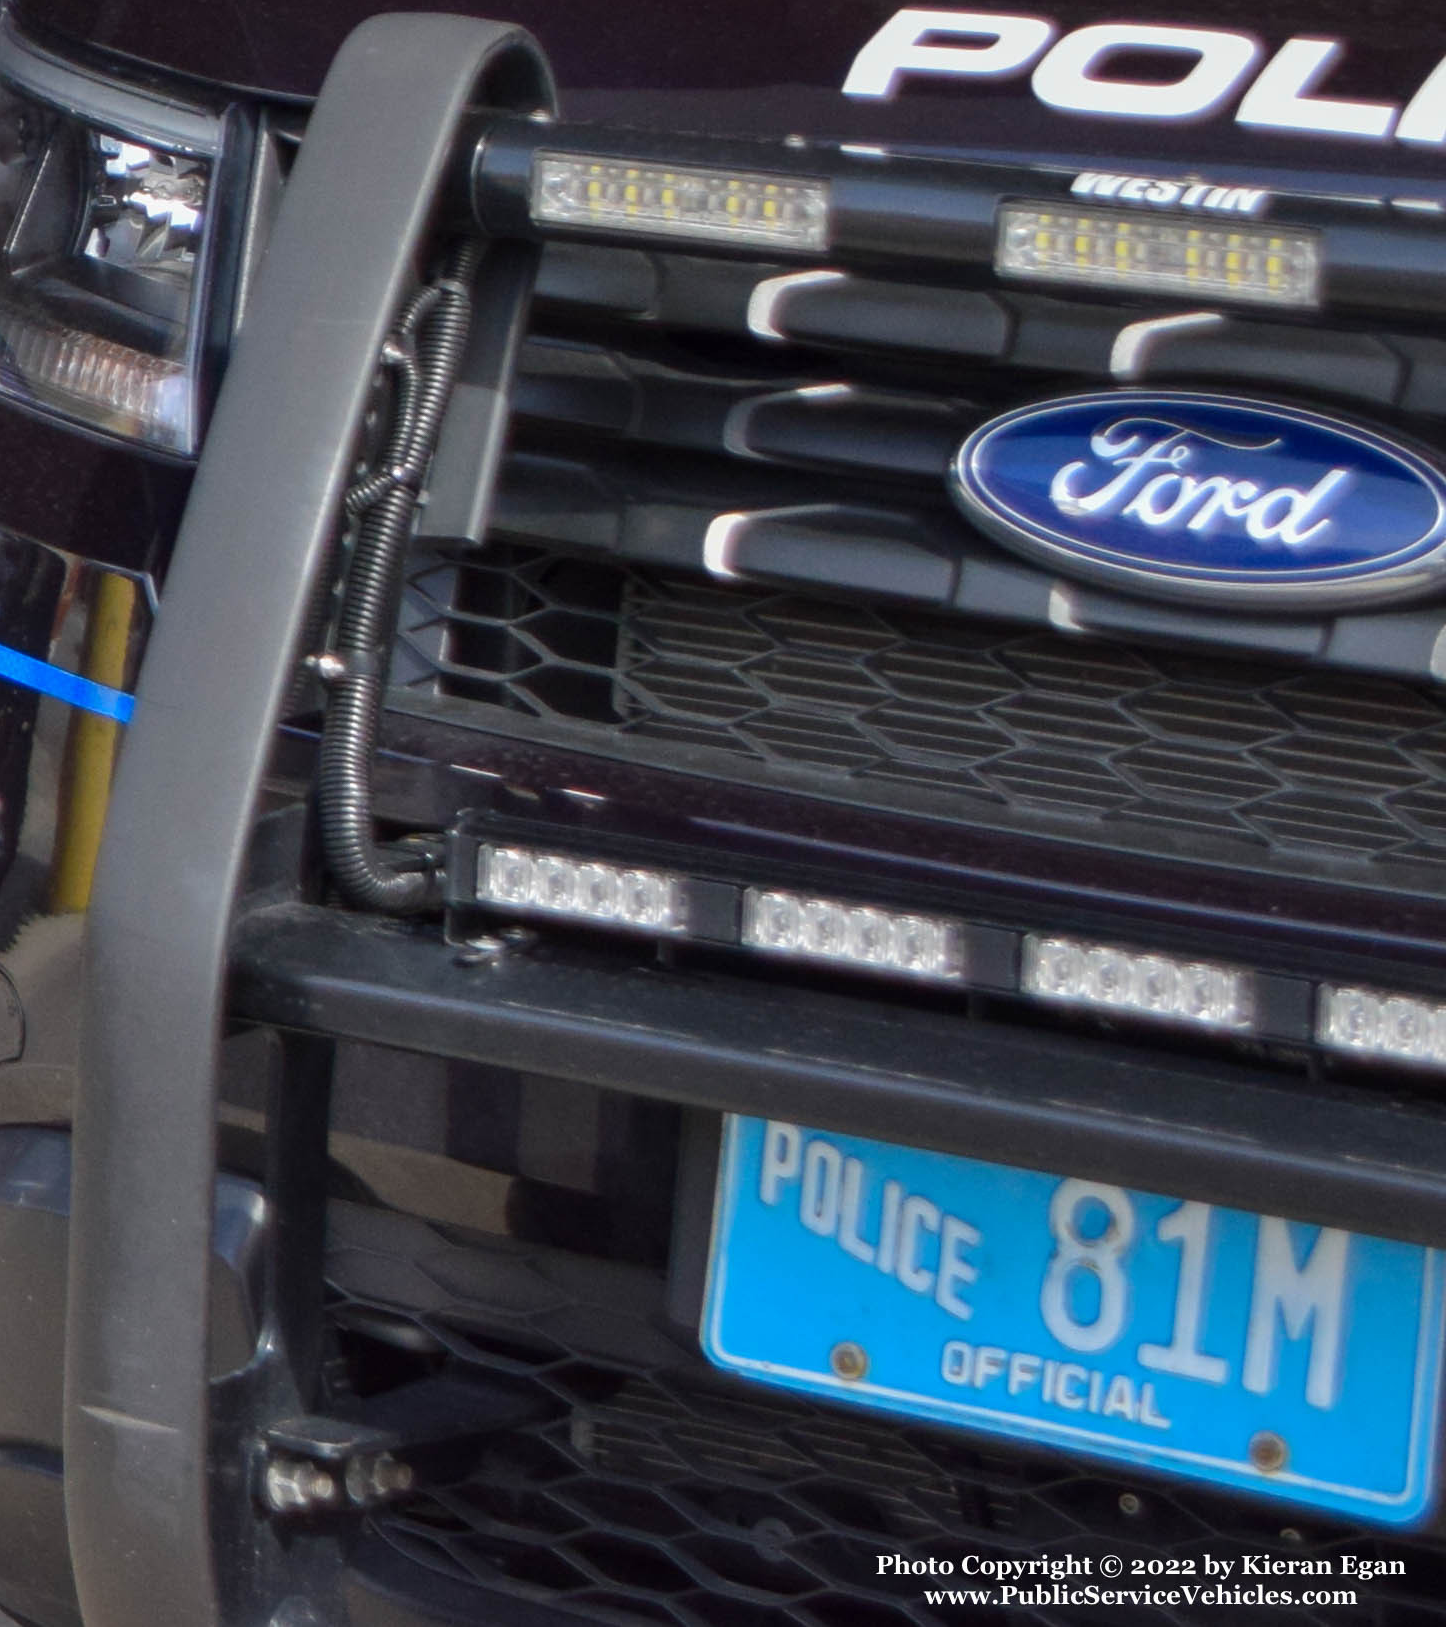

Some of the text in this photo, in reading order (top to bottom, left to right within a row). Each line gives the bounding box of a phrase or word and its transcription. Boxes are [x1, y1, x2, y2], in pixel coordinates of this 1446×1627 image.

[1069, 172, 1268, 213] WESTIN
[1049, 417, 1349, 546] Ford
[759, 1120, 1352, 1410] POLICE 81M
[941, 1340, 1171, 1430] OFFICIAL
